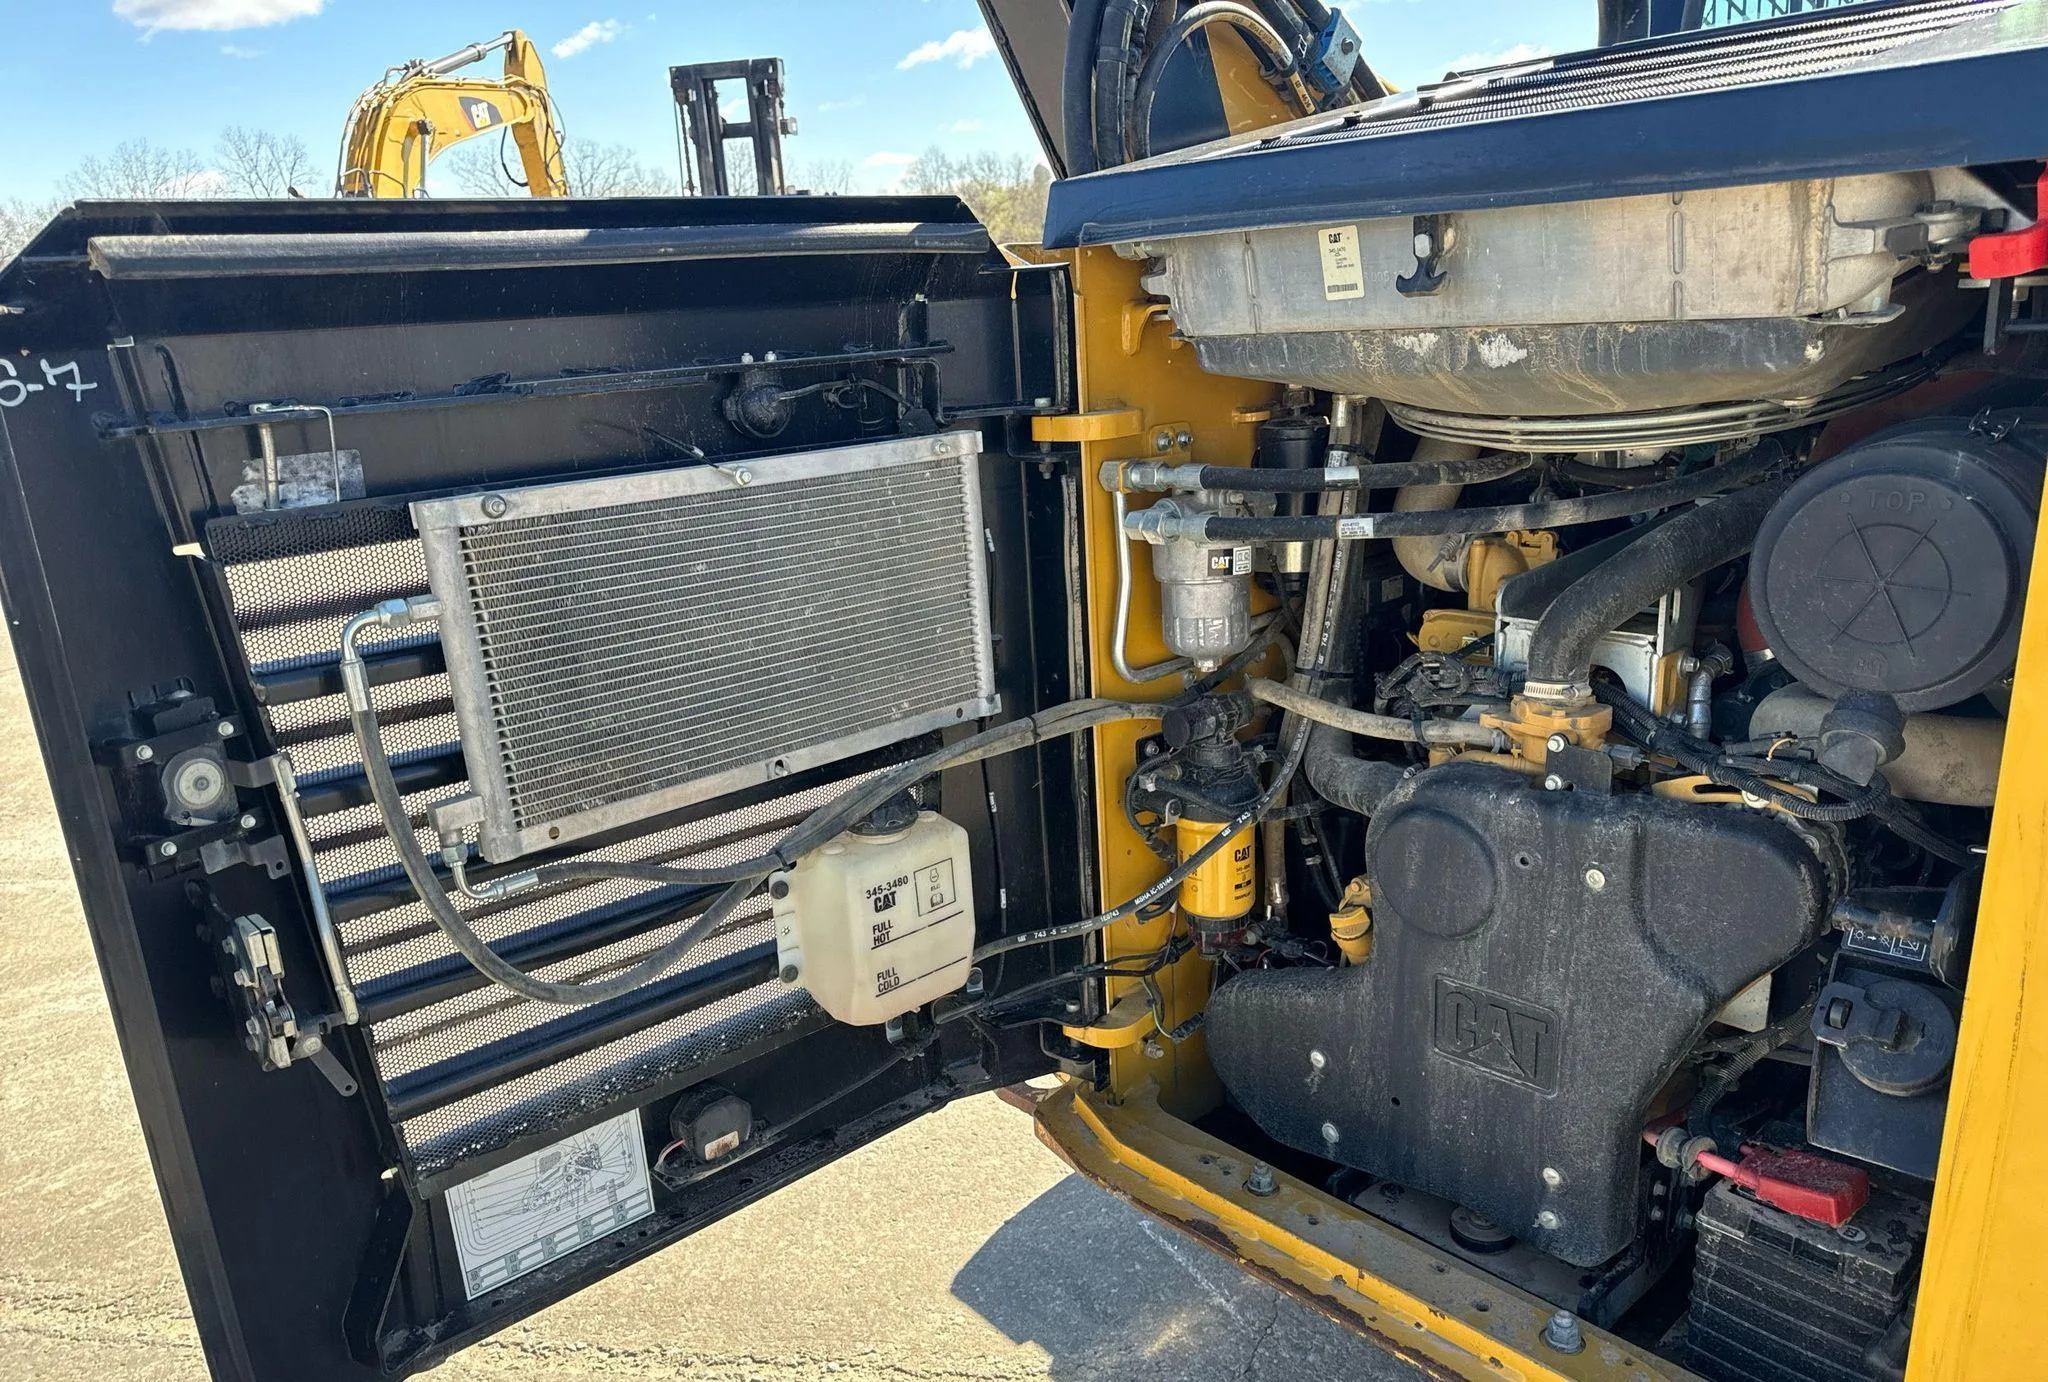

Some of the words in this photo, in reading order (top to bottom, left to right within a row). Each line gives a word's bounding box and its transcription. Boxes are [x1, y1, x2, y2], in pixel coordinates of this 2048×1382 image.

[471, 101, 492, 129] CAT
[1328, 232, 1342, 243] CAT
[1211, 556, 1230, 570] CAT
[1234, 845, 1251, 863] CAT
[866, 875, 908, 899] 345-3480
[873, 890, 897, 914] CAT
[872, 919, 894, 936] FULL
[1033, 930, 1047, 940] 743
[873, 930, 891, 946] HOT
[877, 966, 898, 983] FULL
[878, 976, 900, 993] COLD
[1444, 990, 1549, 1080] CAT
